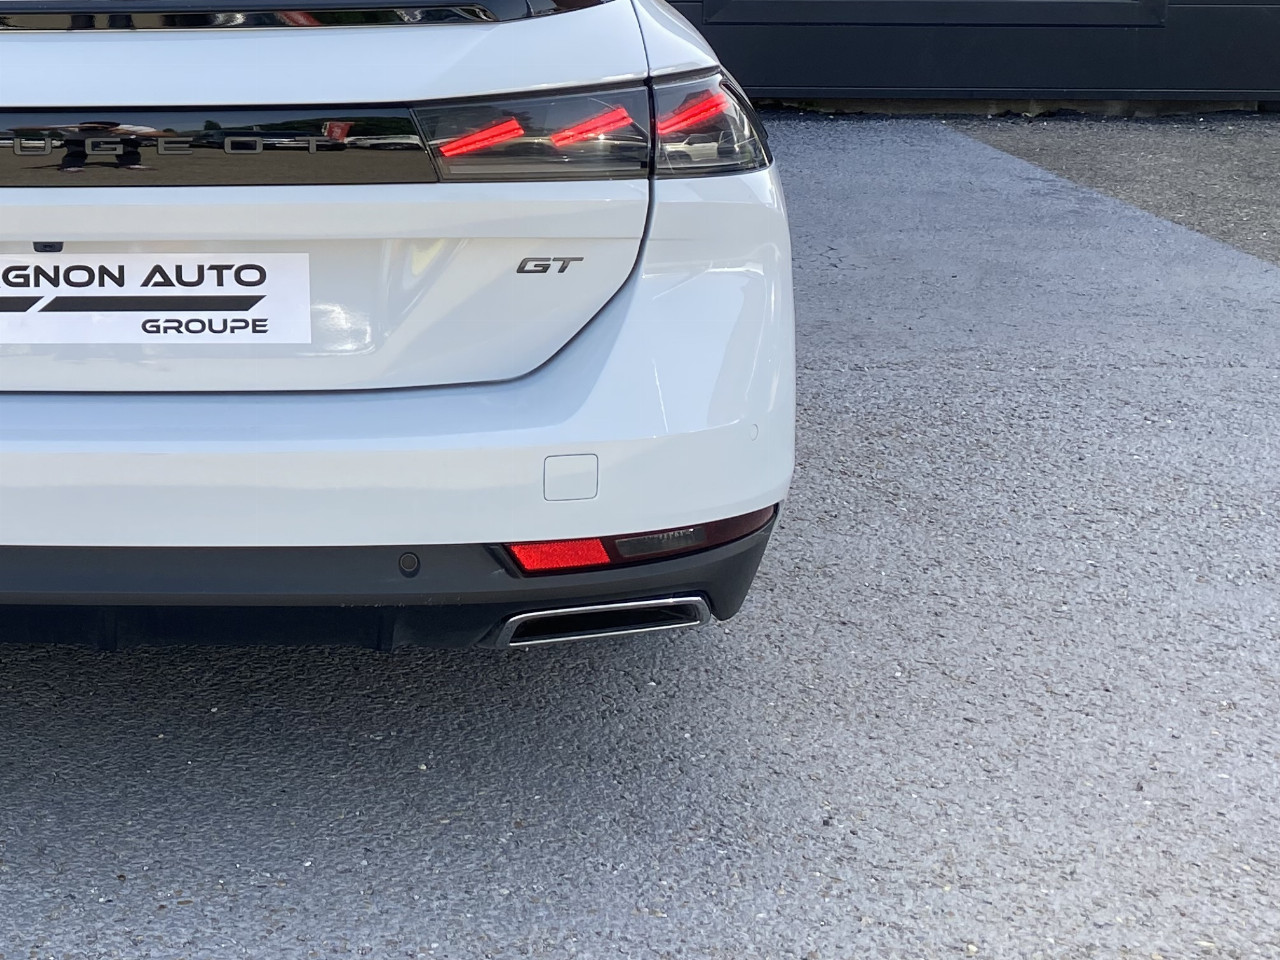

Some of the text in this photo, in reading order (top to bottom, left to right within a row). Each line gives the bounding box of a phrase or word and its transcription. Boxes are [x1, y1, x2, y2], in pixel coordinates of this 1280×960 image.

[516, 256, 584, 274] GT
[140, 263, 268, 288] AUTO
[141, 318, 269, 335] GROUPE
